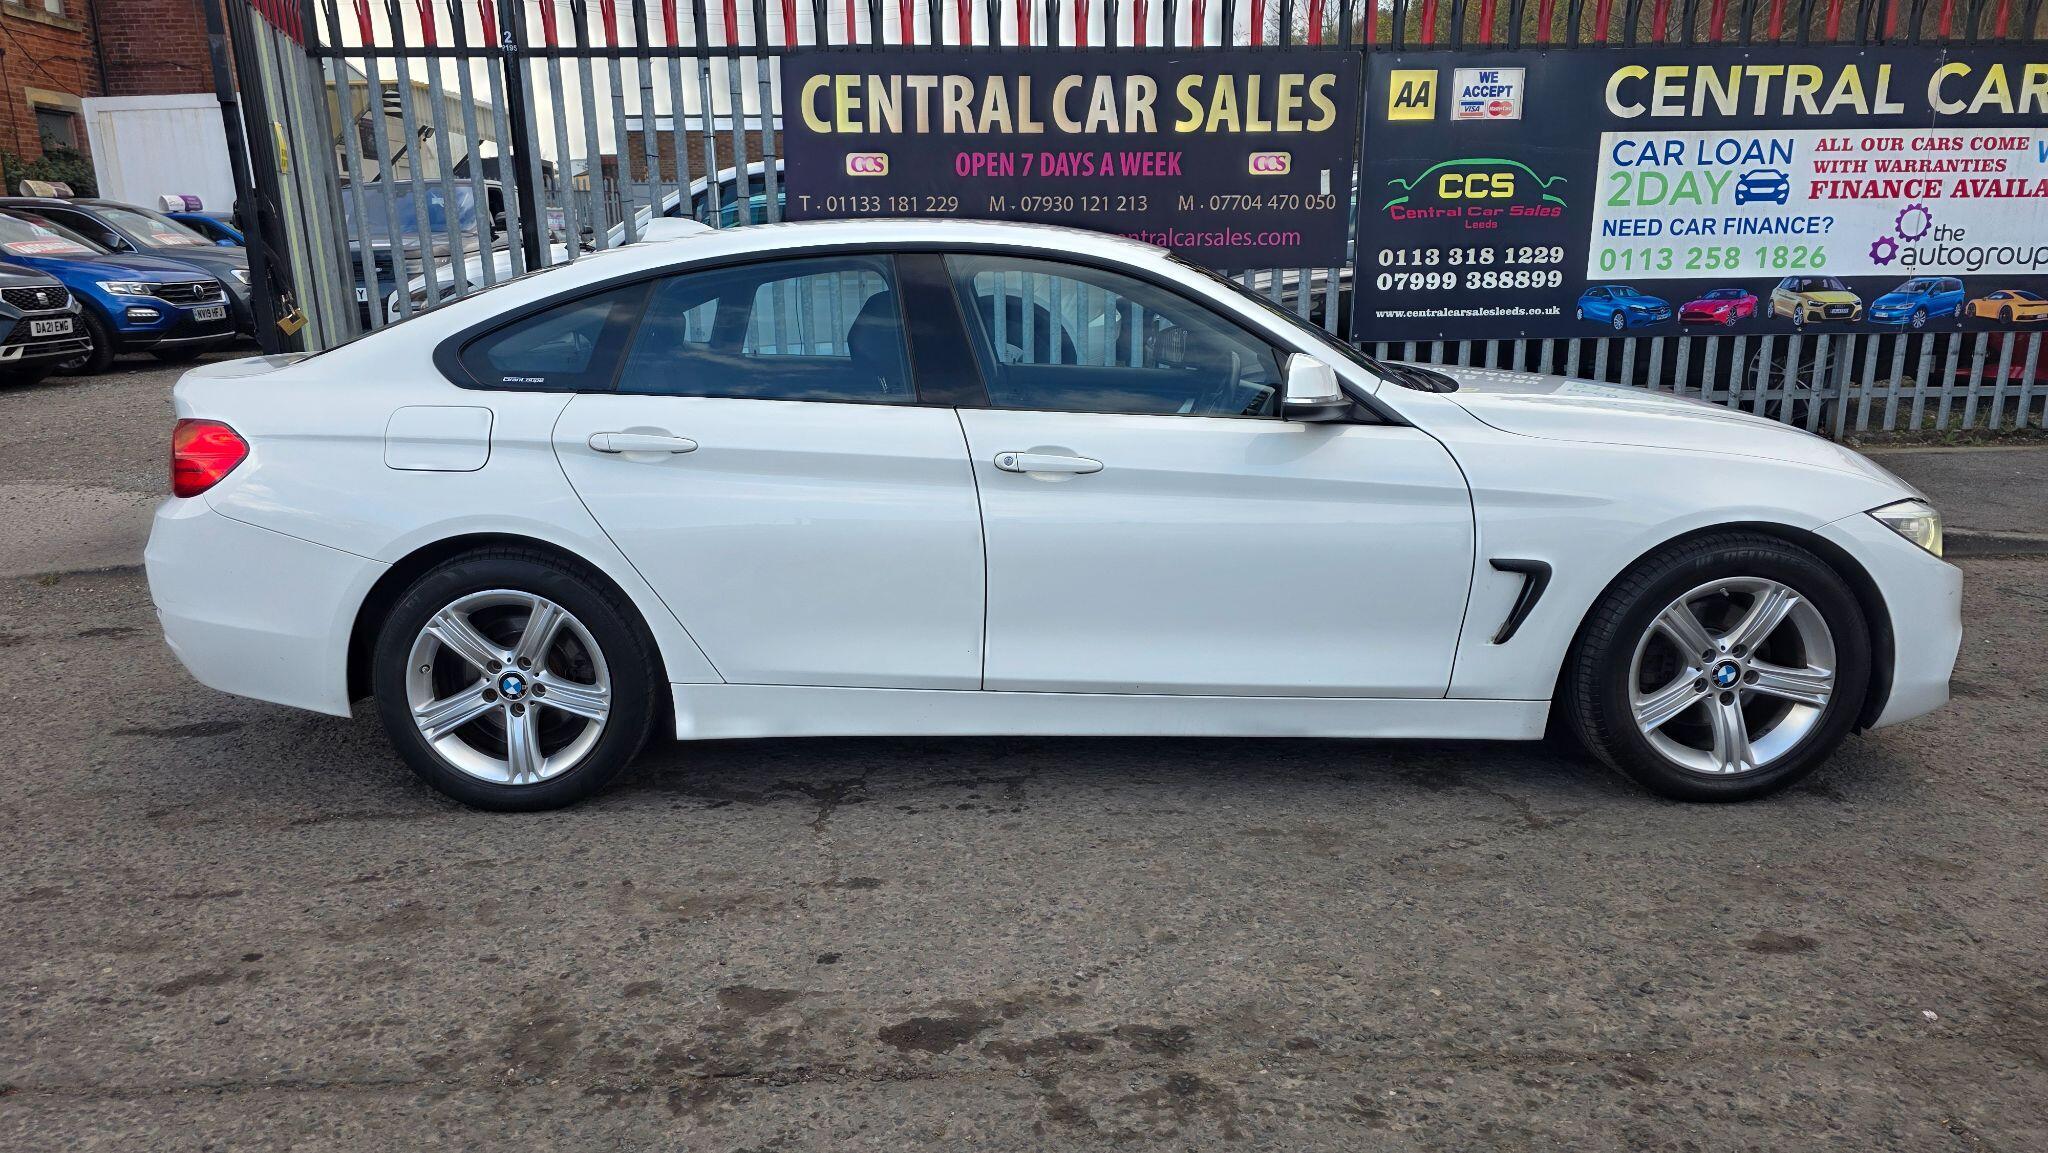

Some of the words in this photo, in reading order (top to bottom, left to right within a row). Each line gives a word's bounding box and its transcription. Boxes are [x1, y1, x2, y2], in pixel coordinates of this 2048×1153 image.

[503, 30, 513, 43] 2
[1479, 71, 1499, 84] WE
[1393, 80, 1431, 108] AA
[1462, 85, 1513, 98] ACCEPT
[1605, 64, 1905, 119] CENTRAL
[1927, 62, 2048, 115] CAR
[801, 74, 1044, 134] CENTRAL
[1052, 74, 1158, 134] CAR
[1174, 73, 1337, 133] SALES
[1612, 139, 1685, 167] CAR
[1697, 138, 1794, 166] LOAN
[1814, 138, 1853, 152] ALL
[1860, 137, 1905, 152] OUR
[1911, 137, 1964, 151] CARS
[1970, 136, 2030, 151] COME
[850, 156, 885, 172] CCS
[955, 152, 1015, 177] OPEN
[1021, 152, 1034, 177] 7
[1040, 152, 1094, 177] DAYS
[1099, 152, 1115, 177] A
[1119, 151, 1182, 177] WEEK
[1253, 155, 1287, 172] CCS
[1813, 159, 1868, 174] WITH
[1874, 158, 2008, 173] WARRANTIES
[1438, 172, 1516, 199] CCS
[1606, 170, 1733, 207] 2DAY
[1808, 178, 1943, 200] FINANCE
[826, 195, 881, 212] 01133
[888, 195, 918, 212] 181
[926, 195, 959, 212] 229
[1020, 195, 1074, 212] 07930
[1081, 195, 1109, 211] 121
[1116, 195, 1148, 211] 213
[1209, 194, 1263, 210] 07704
[1267, 194, 1300, 210] 470
[1304, 194, 1336, 210] 050
[1390, 205, 1462, 221] Central
[1467, 206, 1504, 217] Car
[1509, 204, 1562, 217] Sales
[1465, 220, 1498, 229] Leeds
[1602, 218, 1663, 237] NEED
[1669, 217, 1717, 237] CAR
[1723, 216, 1834, 236] FINANCE?
[1933, 223, 1966, 242] the
[1378, 248, 1441, 267] 0113
[1448, 247, 1495, 266] 318
[1504, 246, 1564, 264] 1229
[1599, 247, 1674, 272] 0113
[1685, 246, 1741, 271] 258
[1755, 245, 1827, 270] 1826
[1900, 243, 2048, 272] autogroup
[1376, 271, 1457, 291] 07999
[1465, 270, 1563, 289] 388899
[1376, 305, 1561, 319] www.centralcarsalesleeds.co.uk
[35, 319, 54, 334] DA21
